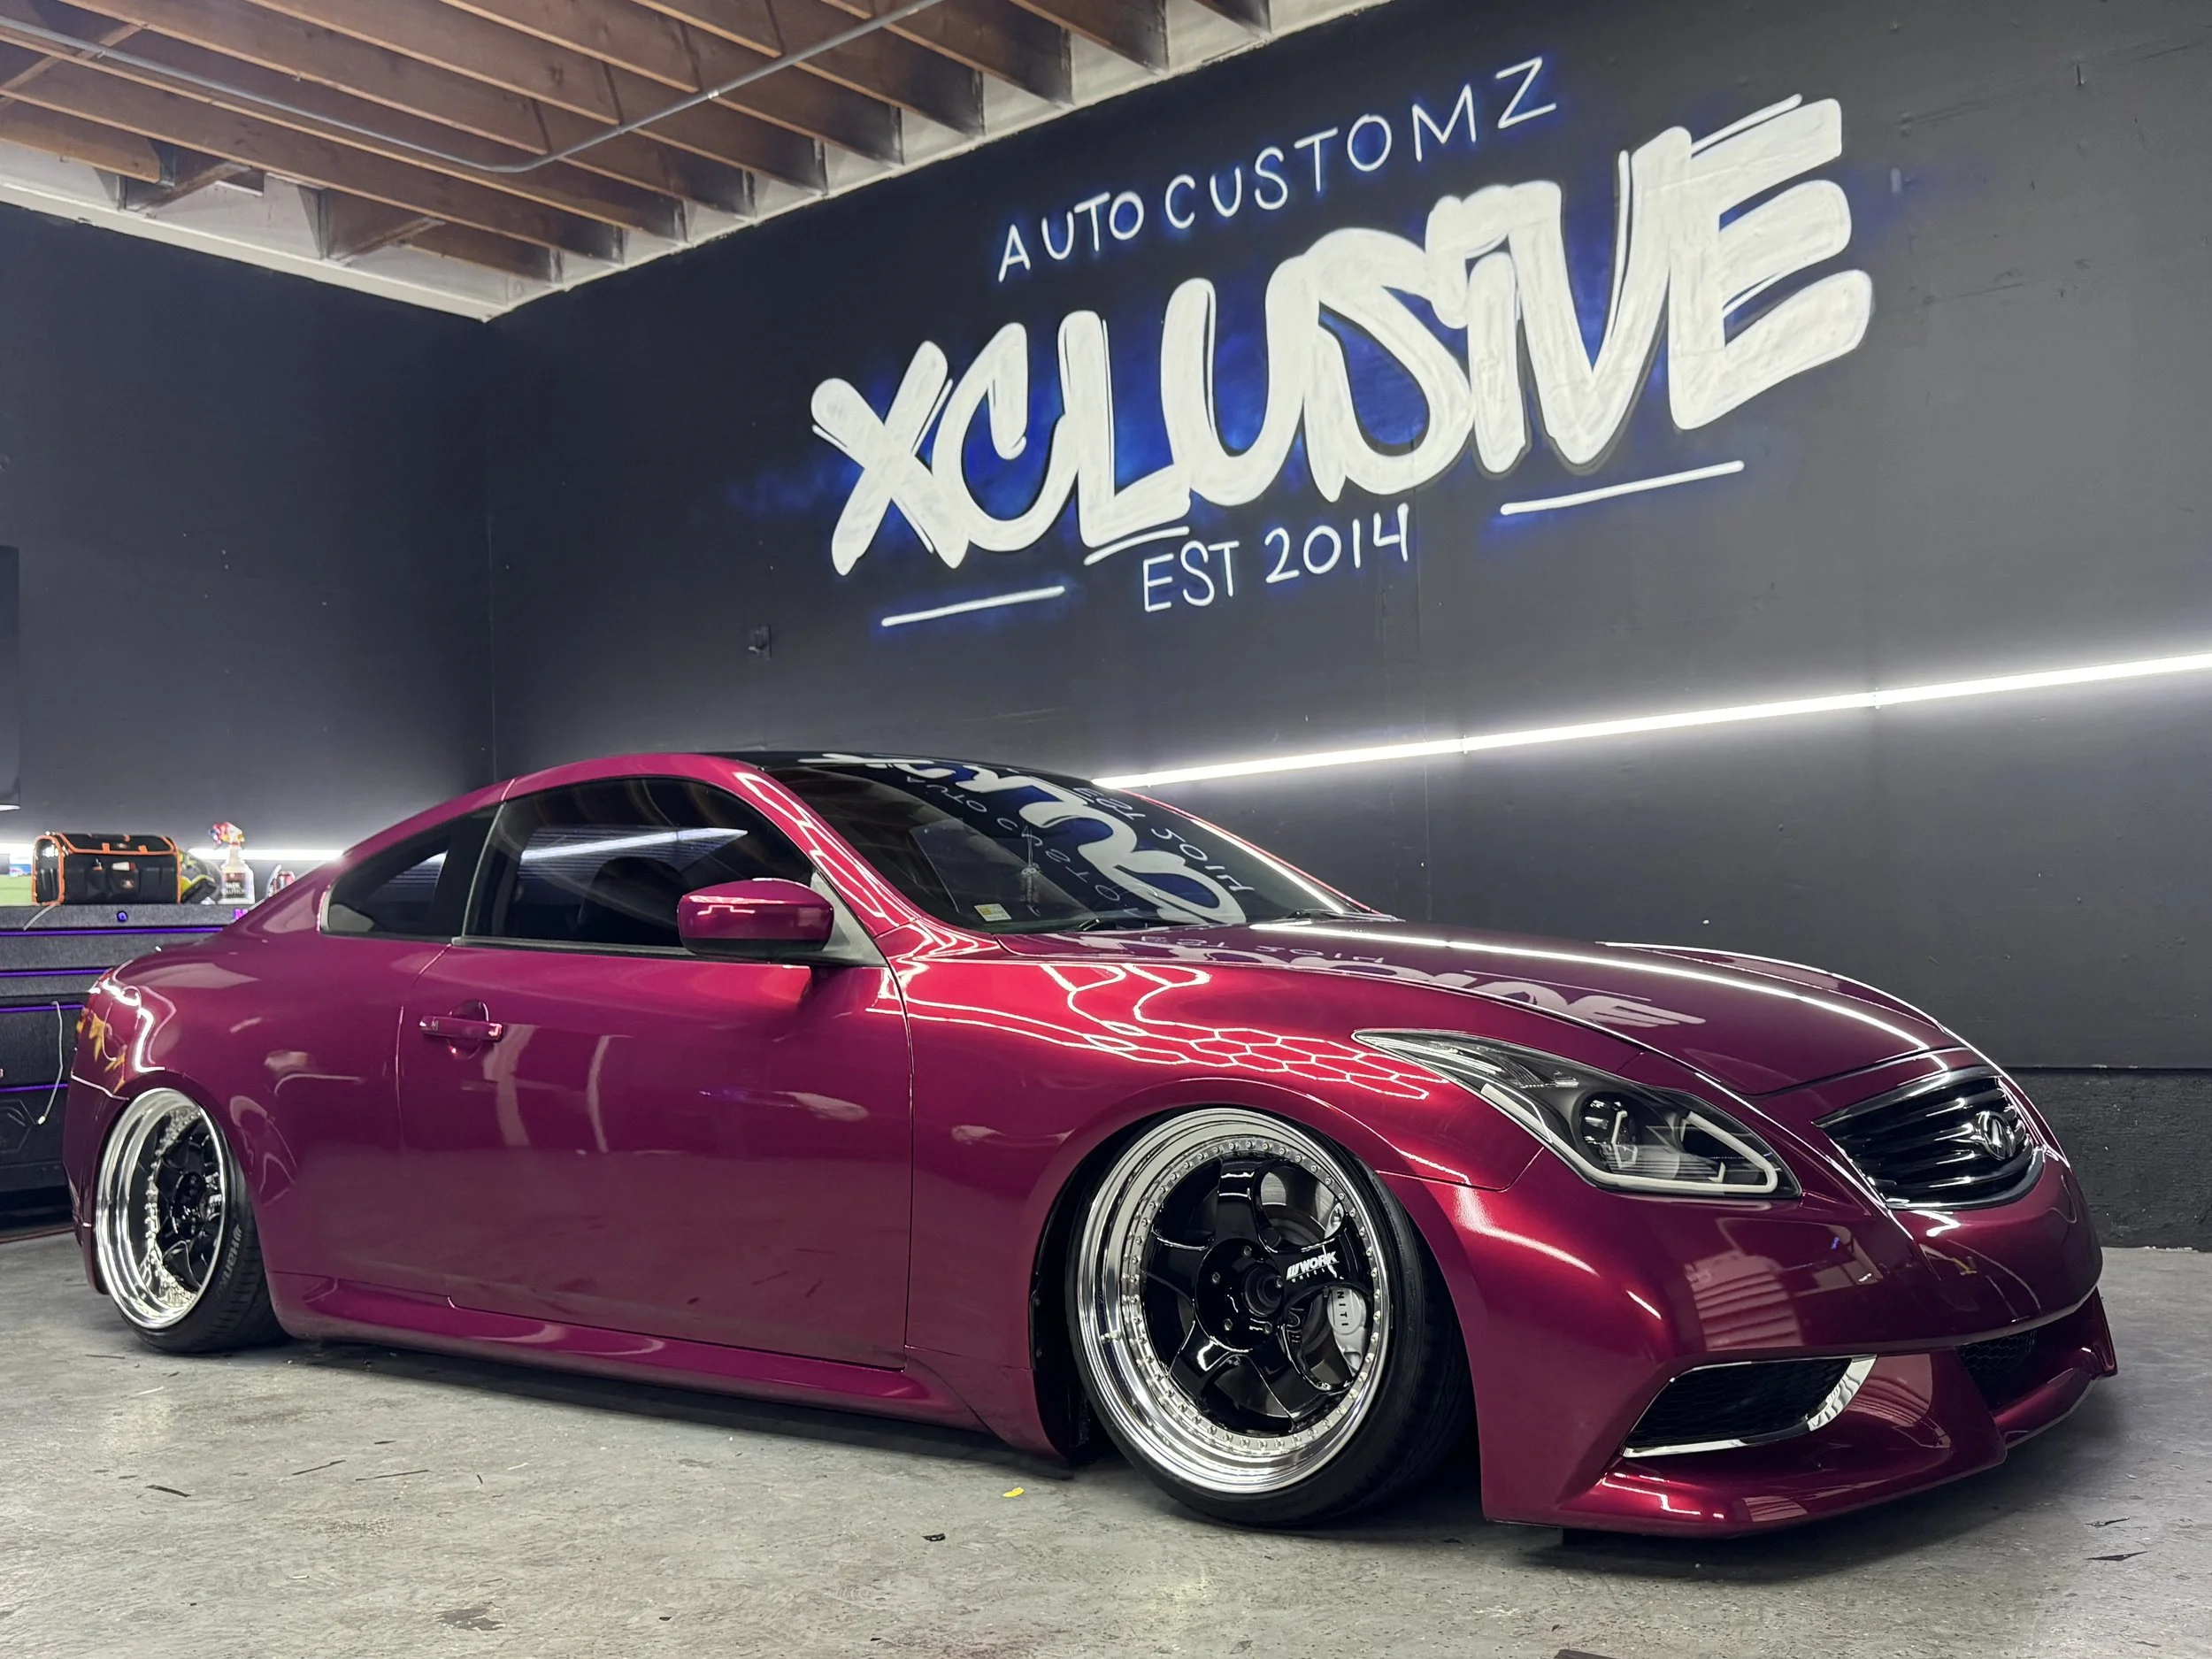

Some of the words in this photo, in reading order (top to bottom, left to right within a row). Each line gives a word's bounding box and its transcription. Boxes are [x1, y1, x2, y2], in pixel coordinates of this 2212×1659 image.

[810, 95, 1873, 575] XCLUSIVE
[1142, 540, 1240, 613] EST
[1263, 502, 1409, 584] 2014
[1299, 1251, 1339, 1273] WORK
